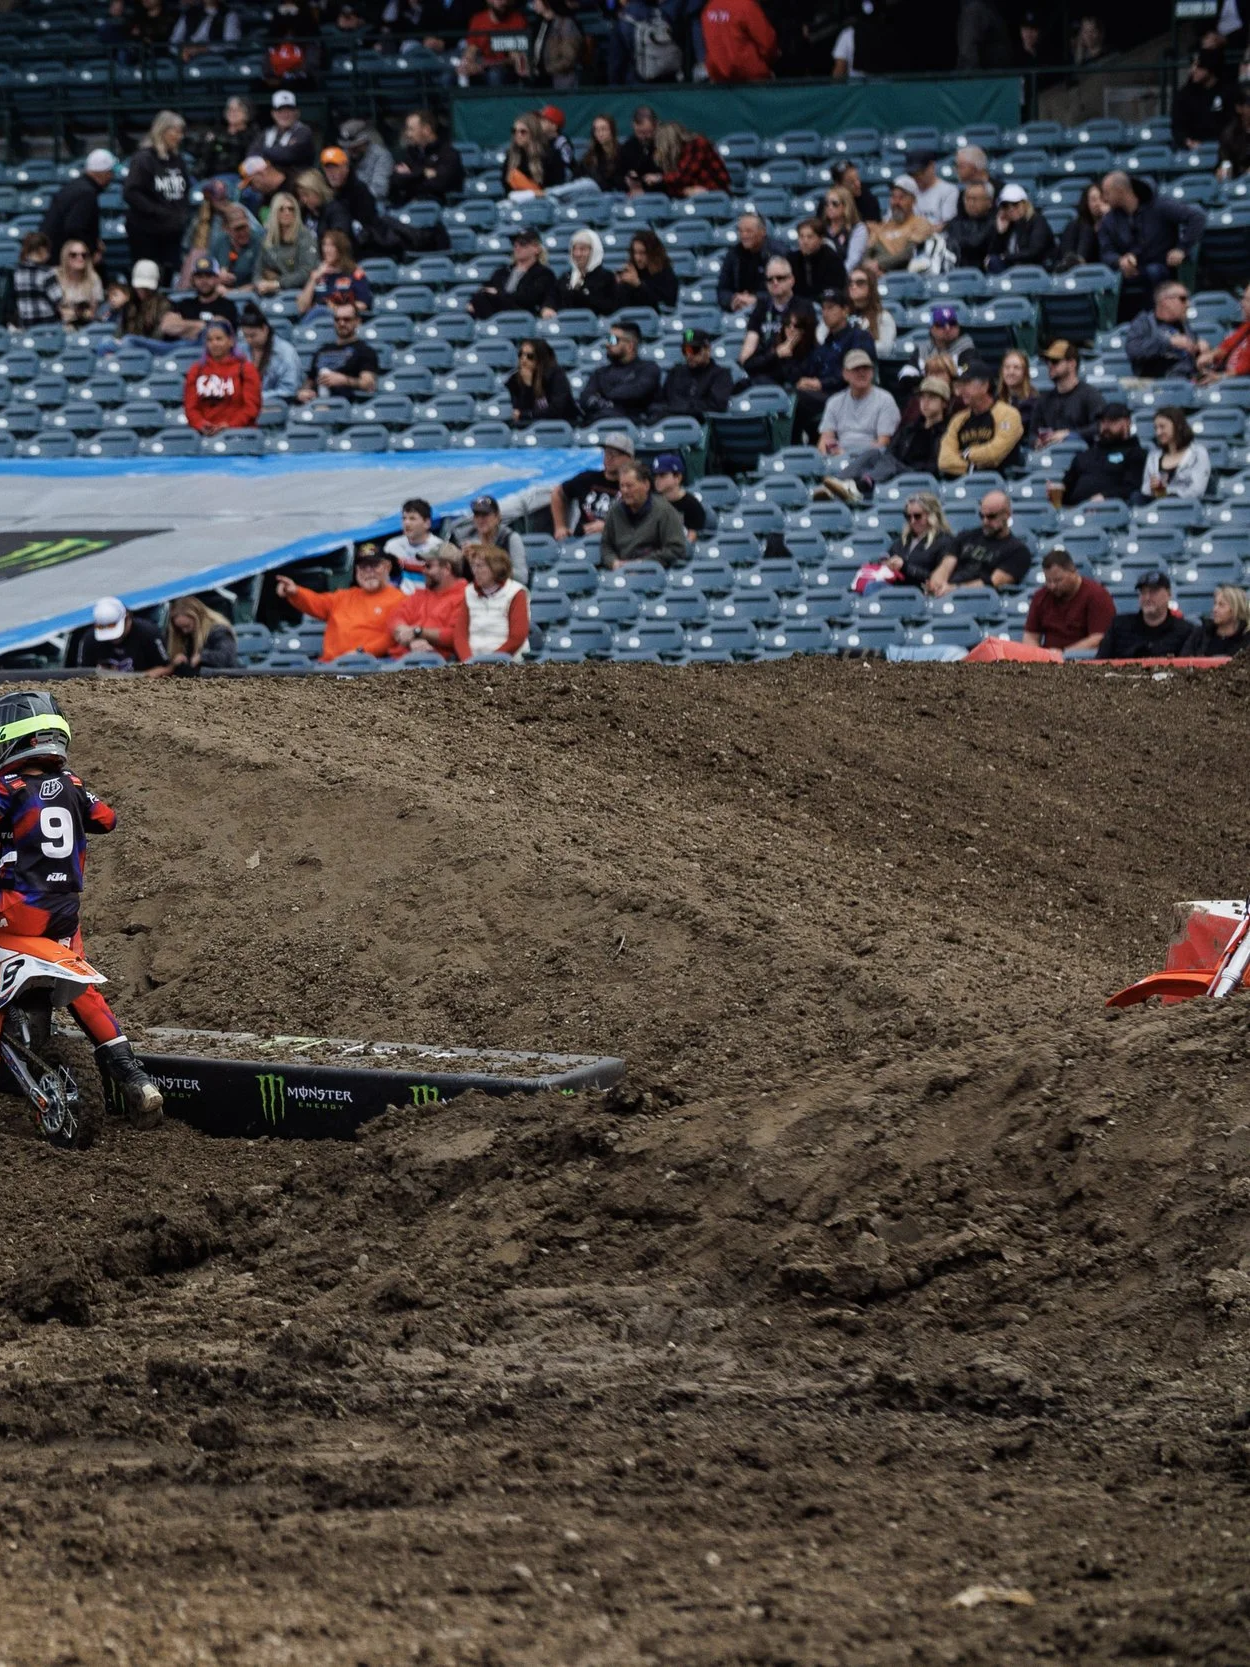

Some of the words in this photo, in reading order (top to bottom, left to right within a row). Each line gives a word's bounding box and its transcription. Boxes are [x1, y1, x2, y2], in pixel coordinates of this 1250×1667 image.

[39, 806, 75, 859] 9
[46, 872, 68, 882] KTM
[150, 1074, 201, 1092] NSTER
[164, 1091, 192, 1099] ERGY
[287, 1086, 353, 1103] MONSTER
[298, 1102, 345, 1111] ENERGY
